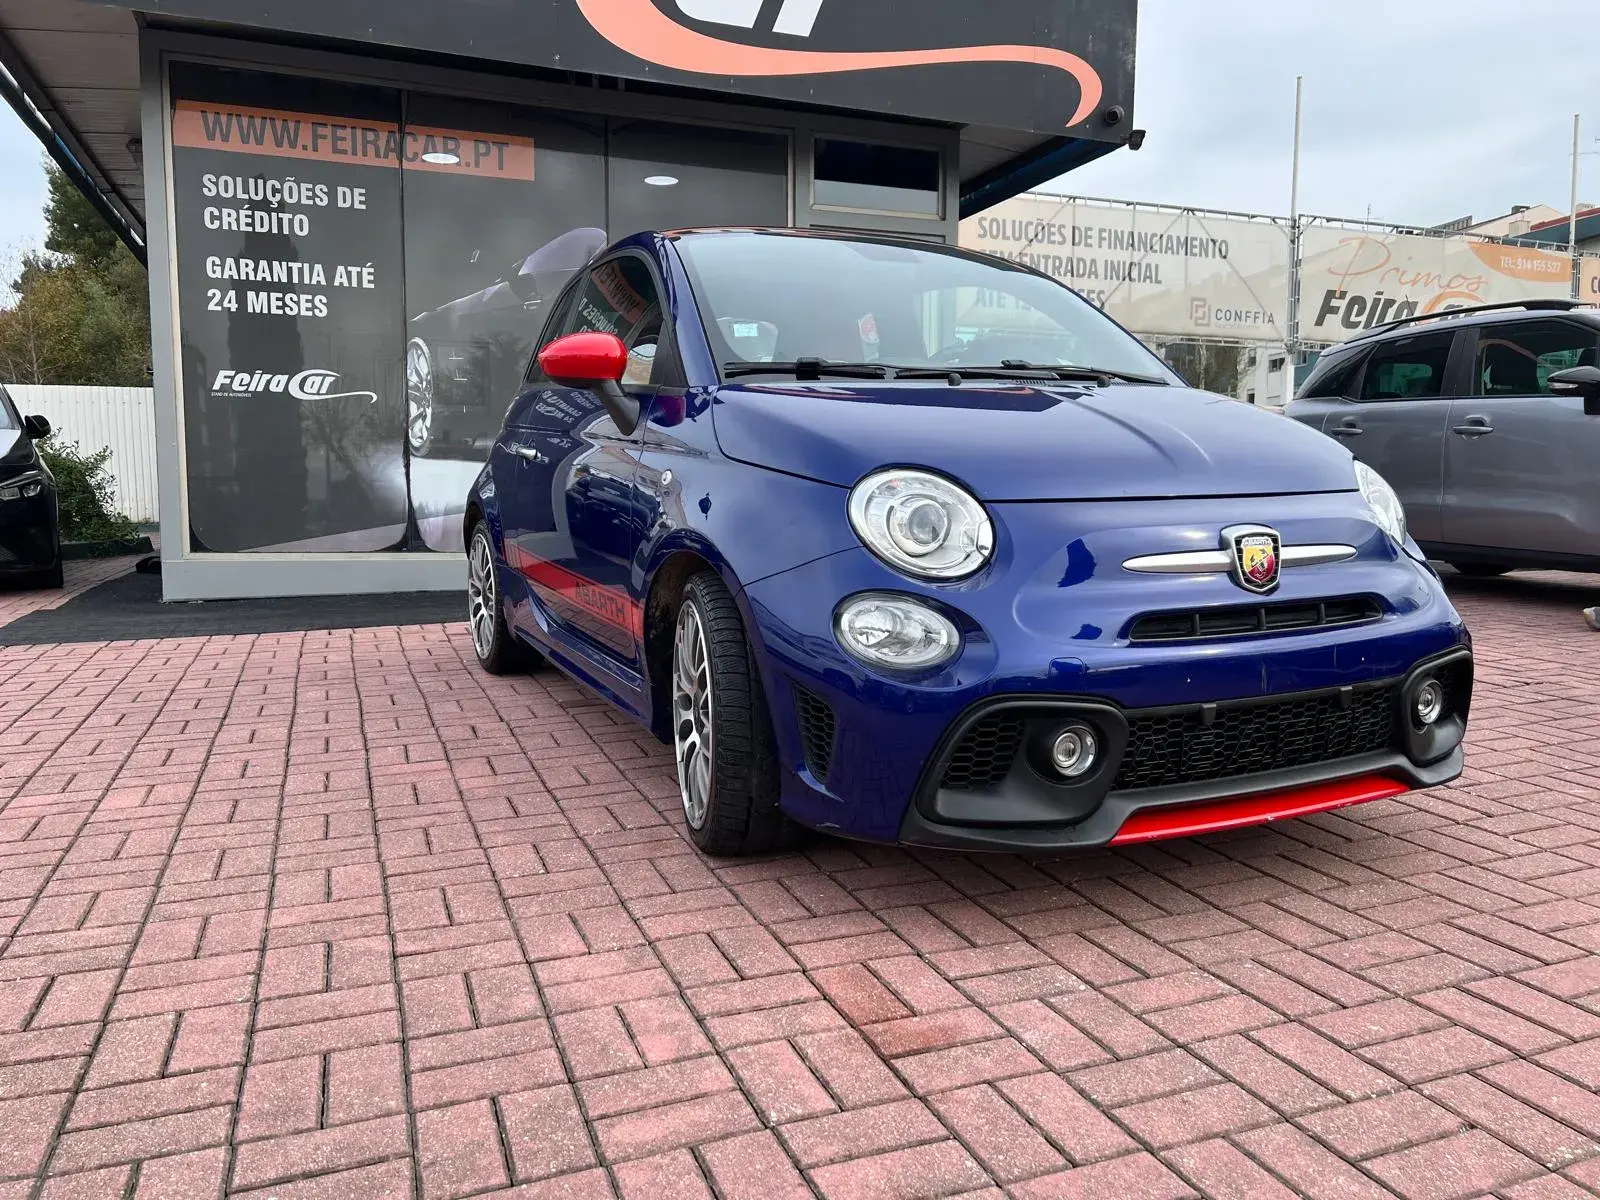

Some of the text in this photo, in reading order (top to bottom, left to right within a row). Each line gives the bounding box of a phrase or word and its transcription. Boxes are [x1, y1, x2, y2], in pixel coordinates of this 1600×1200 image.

[200, 110, 509, 171] WWW.FEIRACAR.PT
[202, 173, 367, 210] SOLUÇÕES DE
[203, 205, 310, 237] CRÉDITO
[1071, 225, 1093, 248] DE
[1098, 227, 1229, 260] FINANCIAMENTO
[205, 255, 375, 289] GARANTIA ATÉ
[1019, 252, 1099, 279] ENTRADA
[1104, 259, 1162, 285] INICIAL
[1327, 237, 1488, 297] Primos
[207, 288, 328, 317] 24 MESES
[1215, 308, 1275, 325] CONFFIA
[576, 581, 625, 623] ABARTH
